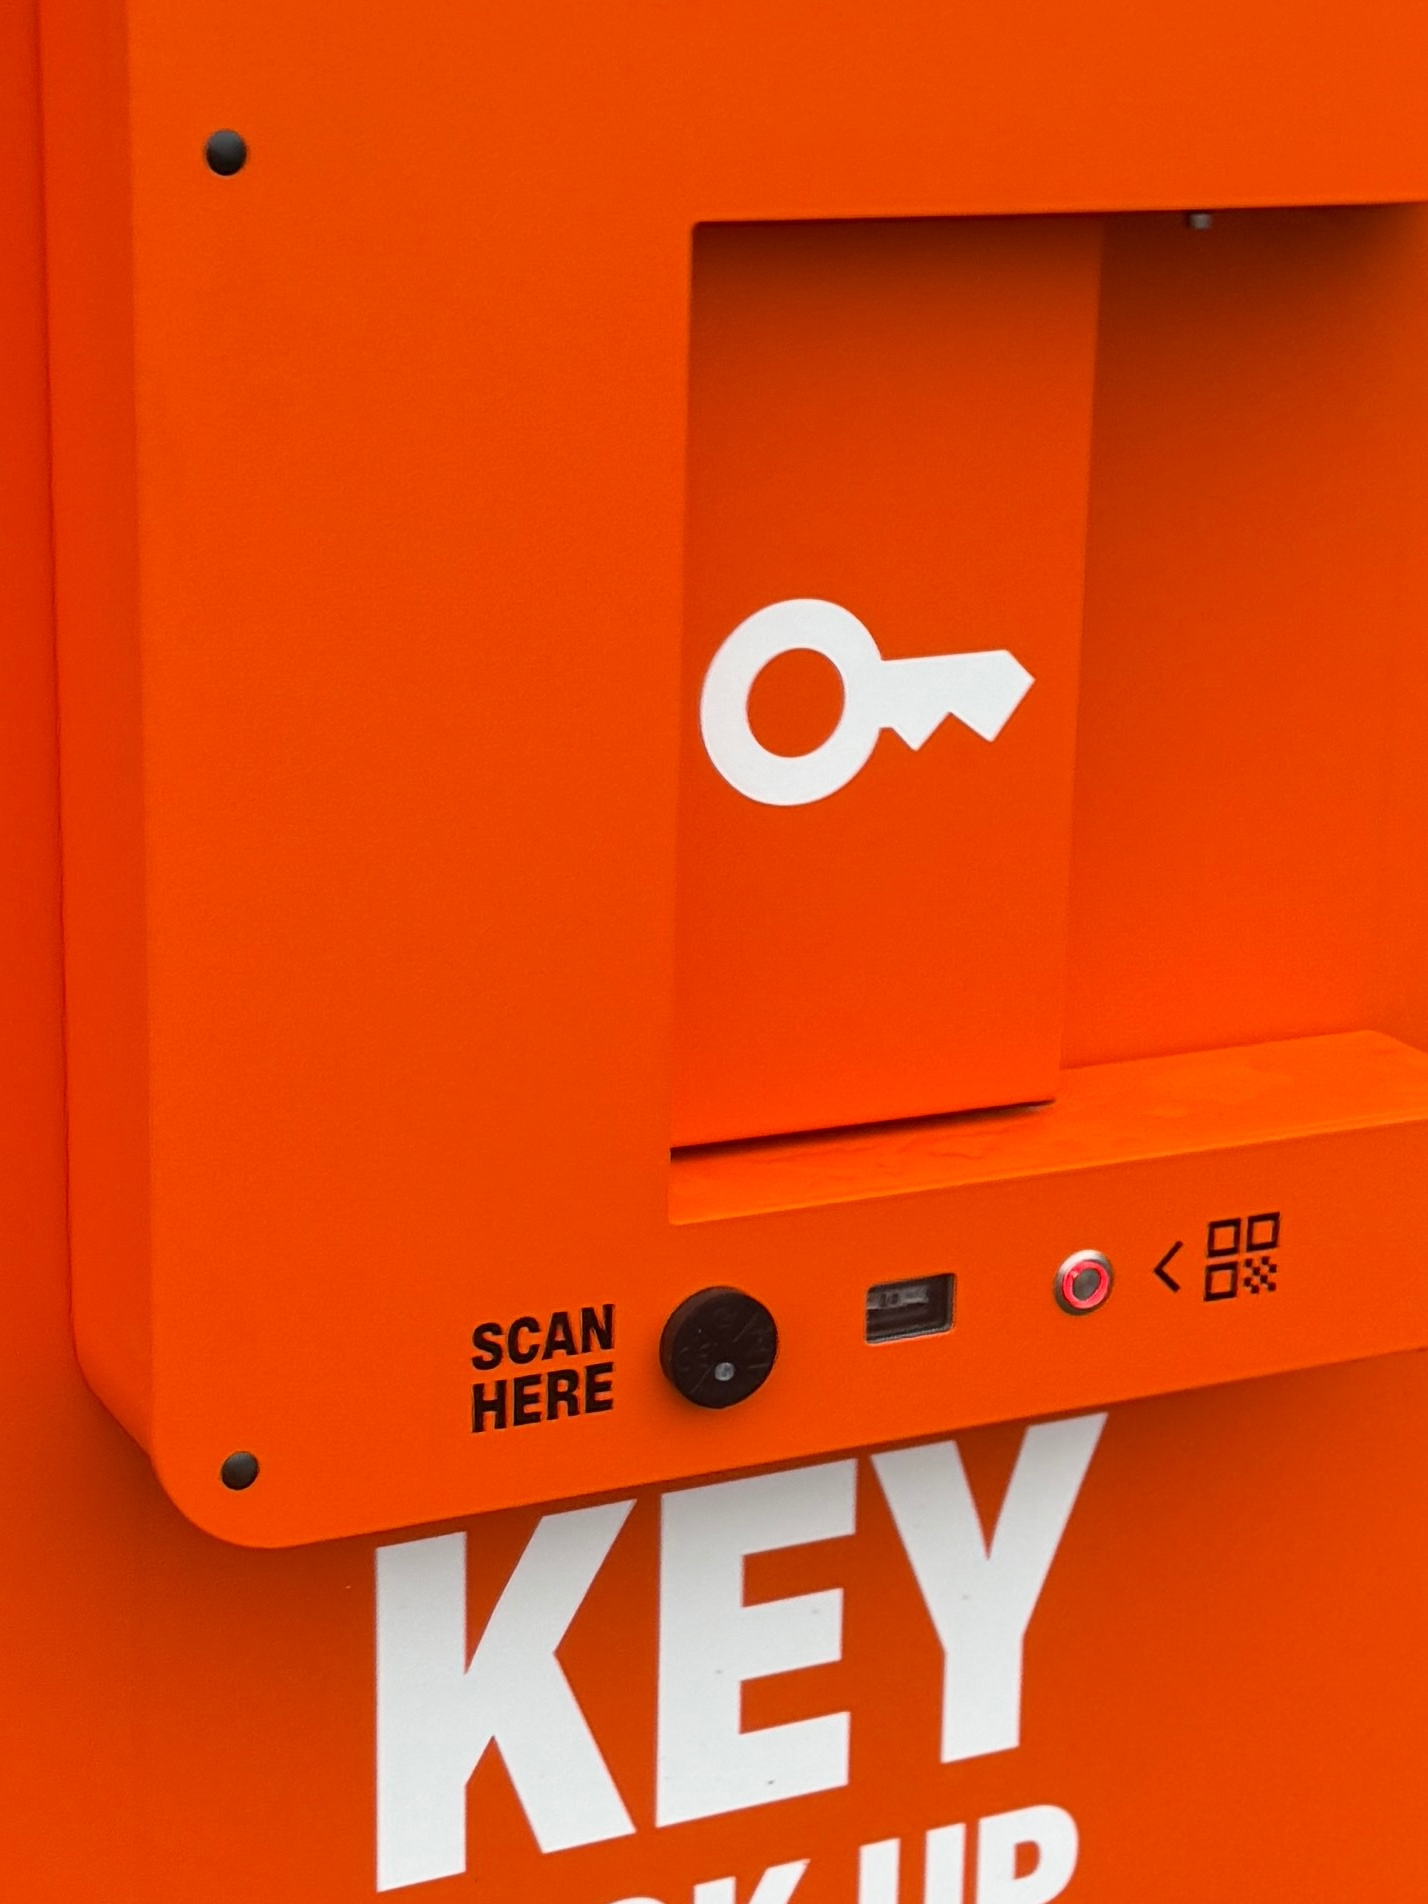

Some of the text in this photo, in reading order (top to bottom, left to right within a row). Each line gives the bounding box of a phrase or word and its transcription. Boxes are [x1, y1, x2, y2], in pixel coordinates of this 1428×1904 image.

[471, 1303, 616, 1372] SCAN
[471, 1361, 615, 1434] HERE
[375, 1412, 1109, 1894] KEY
